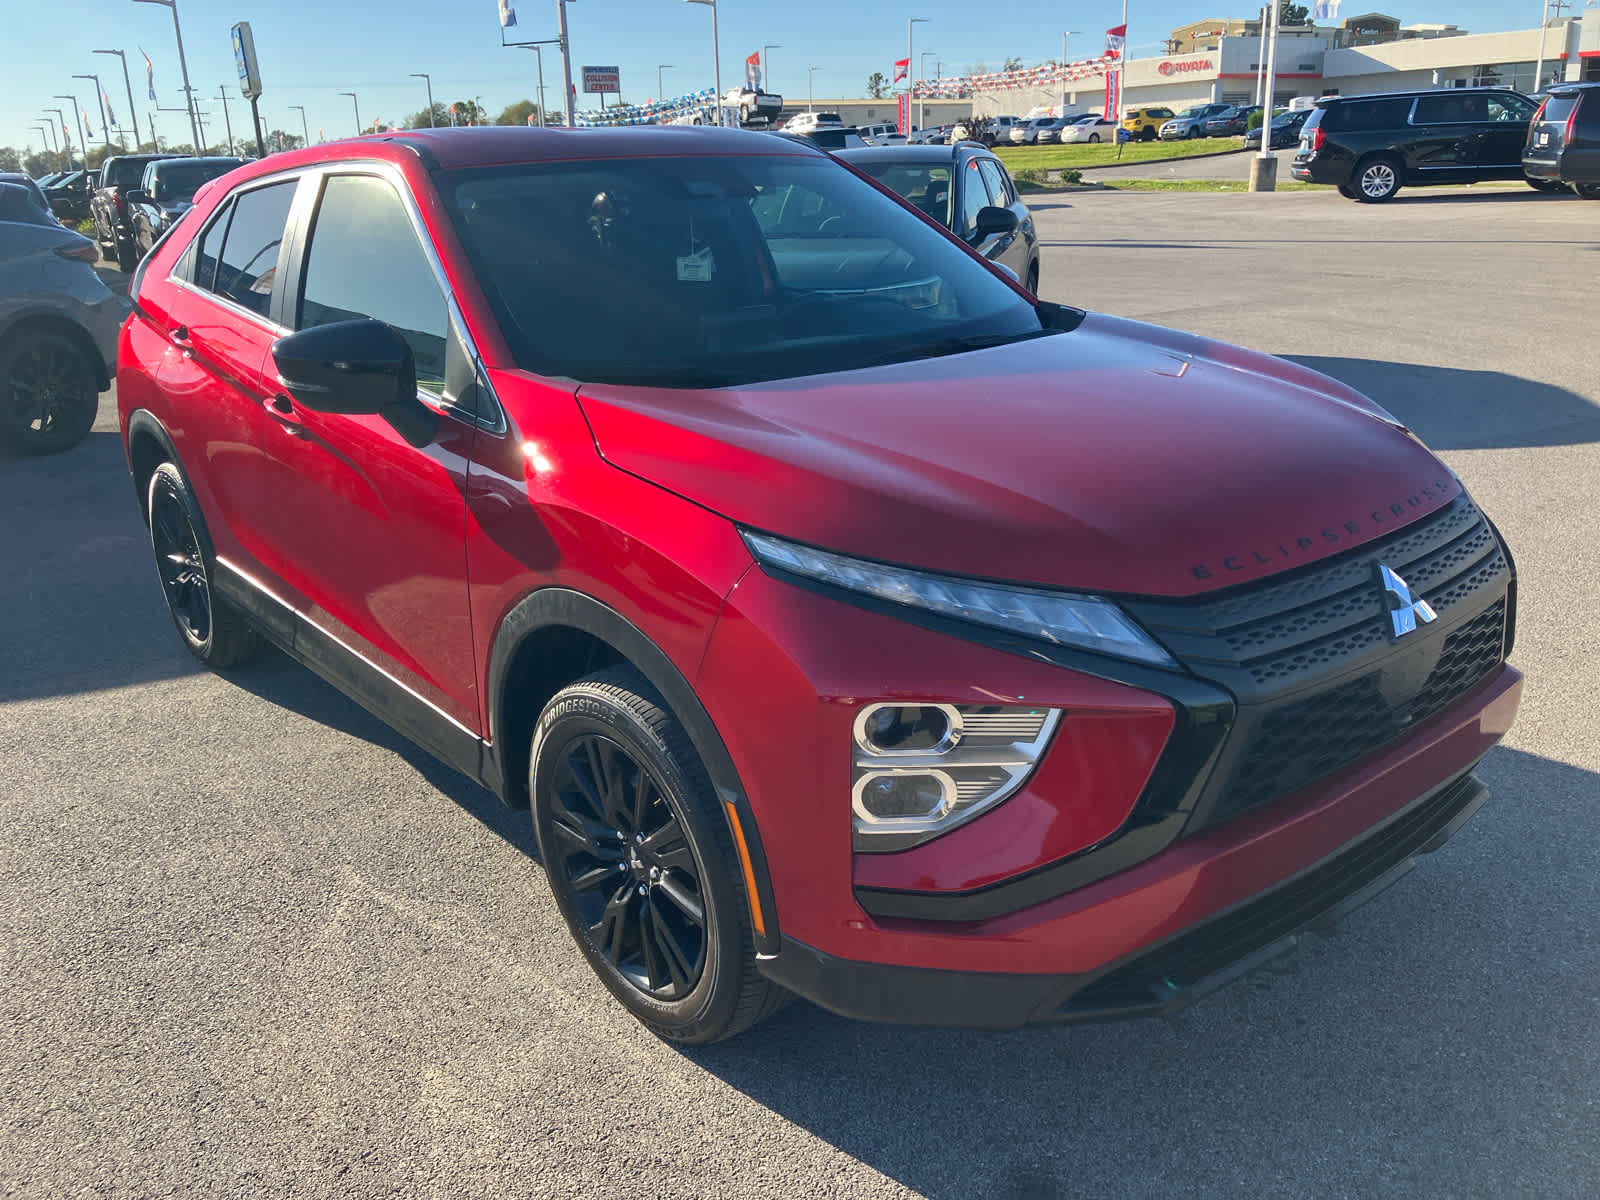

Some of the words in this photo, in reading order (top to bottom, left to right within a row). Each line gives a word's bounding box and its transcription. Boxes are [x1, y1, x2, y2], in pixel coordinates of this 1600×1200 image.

[1175, 60, 1210, 72] TOYOTA
[1191, 519, 1361, 581] ECLIPSE
[1371, 479, 1449, 523] CROSS
[543, 698, 618, 729] BRIDGESTONE
